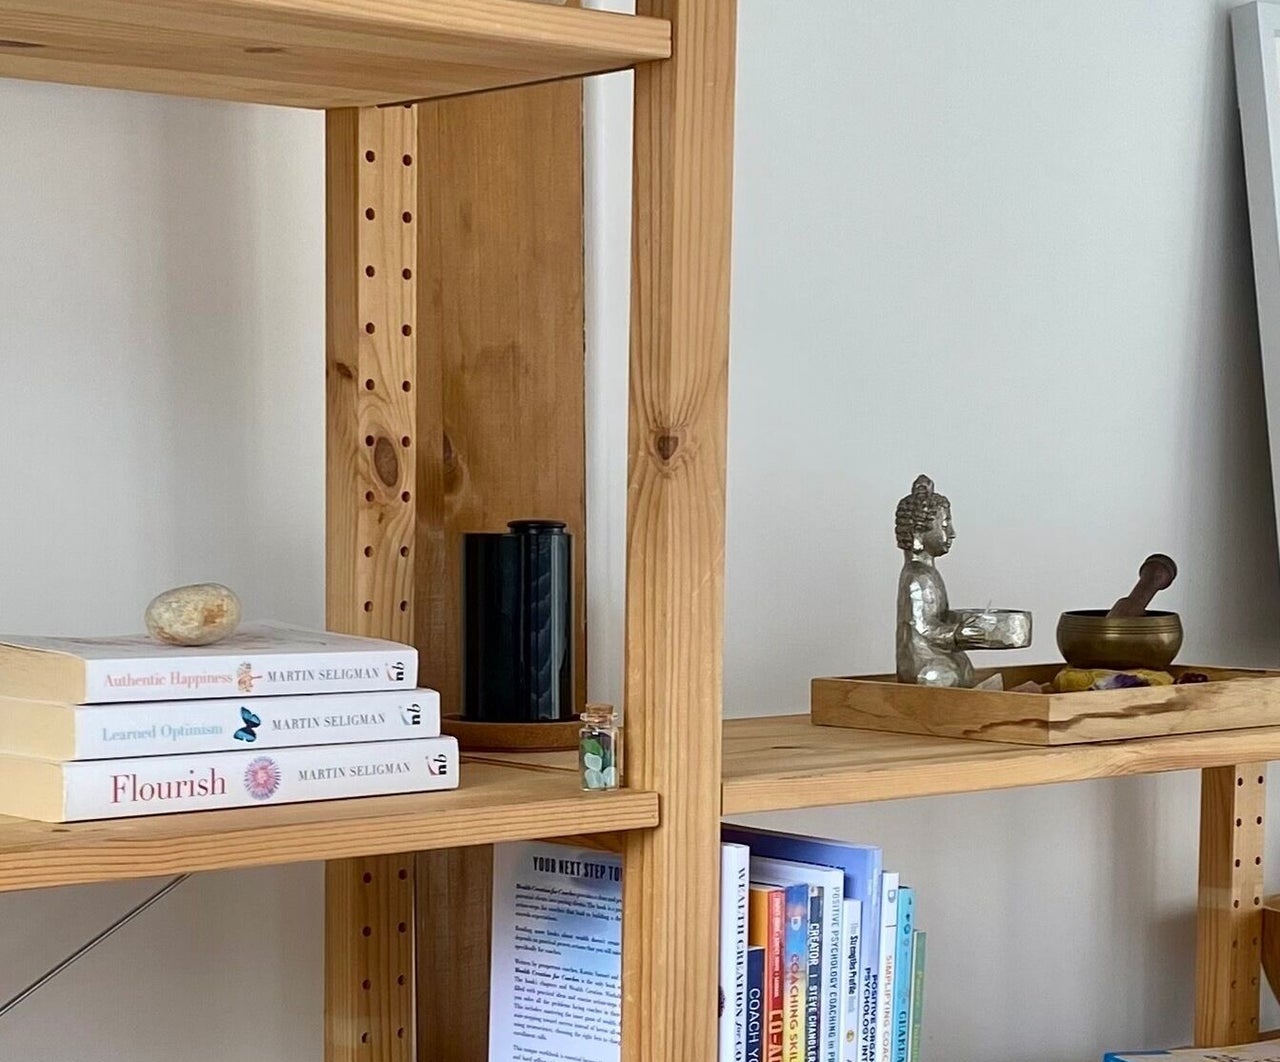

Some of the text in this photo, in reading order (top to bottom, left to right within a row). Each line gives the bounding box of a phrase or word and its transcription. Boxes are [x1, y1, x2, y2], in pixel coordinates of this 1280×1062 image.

[103, 667, 380, 689] Authentic Happiness MARTIN SELIGMAN
[102, 712, 386, 741] Learned Optimism MARTIN SELIGMAN
[110, 762, 411, 804] Flourish MARTIN SELIGMAN
[533, 856, 623, 882] YOUR NEXT STEP TO
[737, 867, 745, 935] WEALTH
[831, 887, 840, 927] POSITIVE
[829, 930, 839, 989] PSYCHOLOGY
[848, 935, 858, 970] Strengths
[735, 939, 744, 1017] CREATION
[789, 954, 800, 1030] COACHING
[807, 923, 820, 1062] CREATOR STEVE CHANDLER
[848, 971, 858, 995] Profile
[883, 955, 892, 1027] SIMPLIFYING
[748, 988, 761, 1043] COACH
[828, 992, 837, 1037] COACHING
[862, 967, 871, 1042] PSYCHOLOGY
[827, 1040, 834, 1048] in
